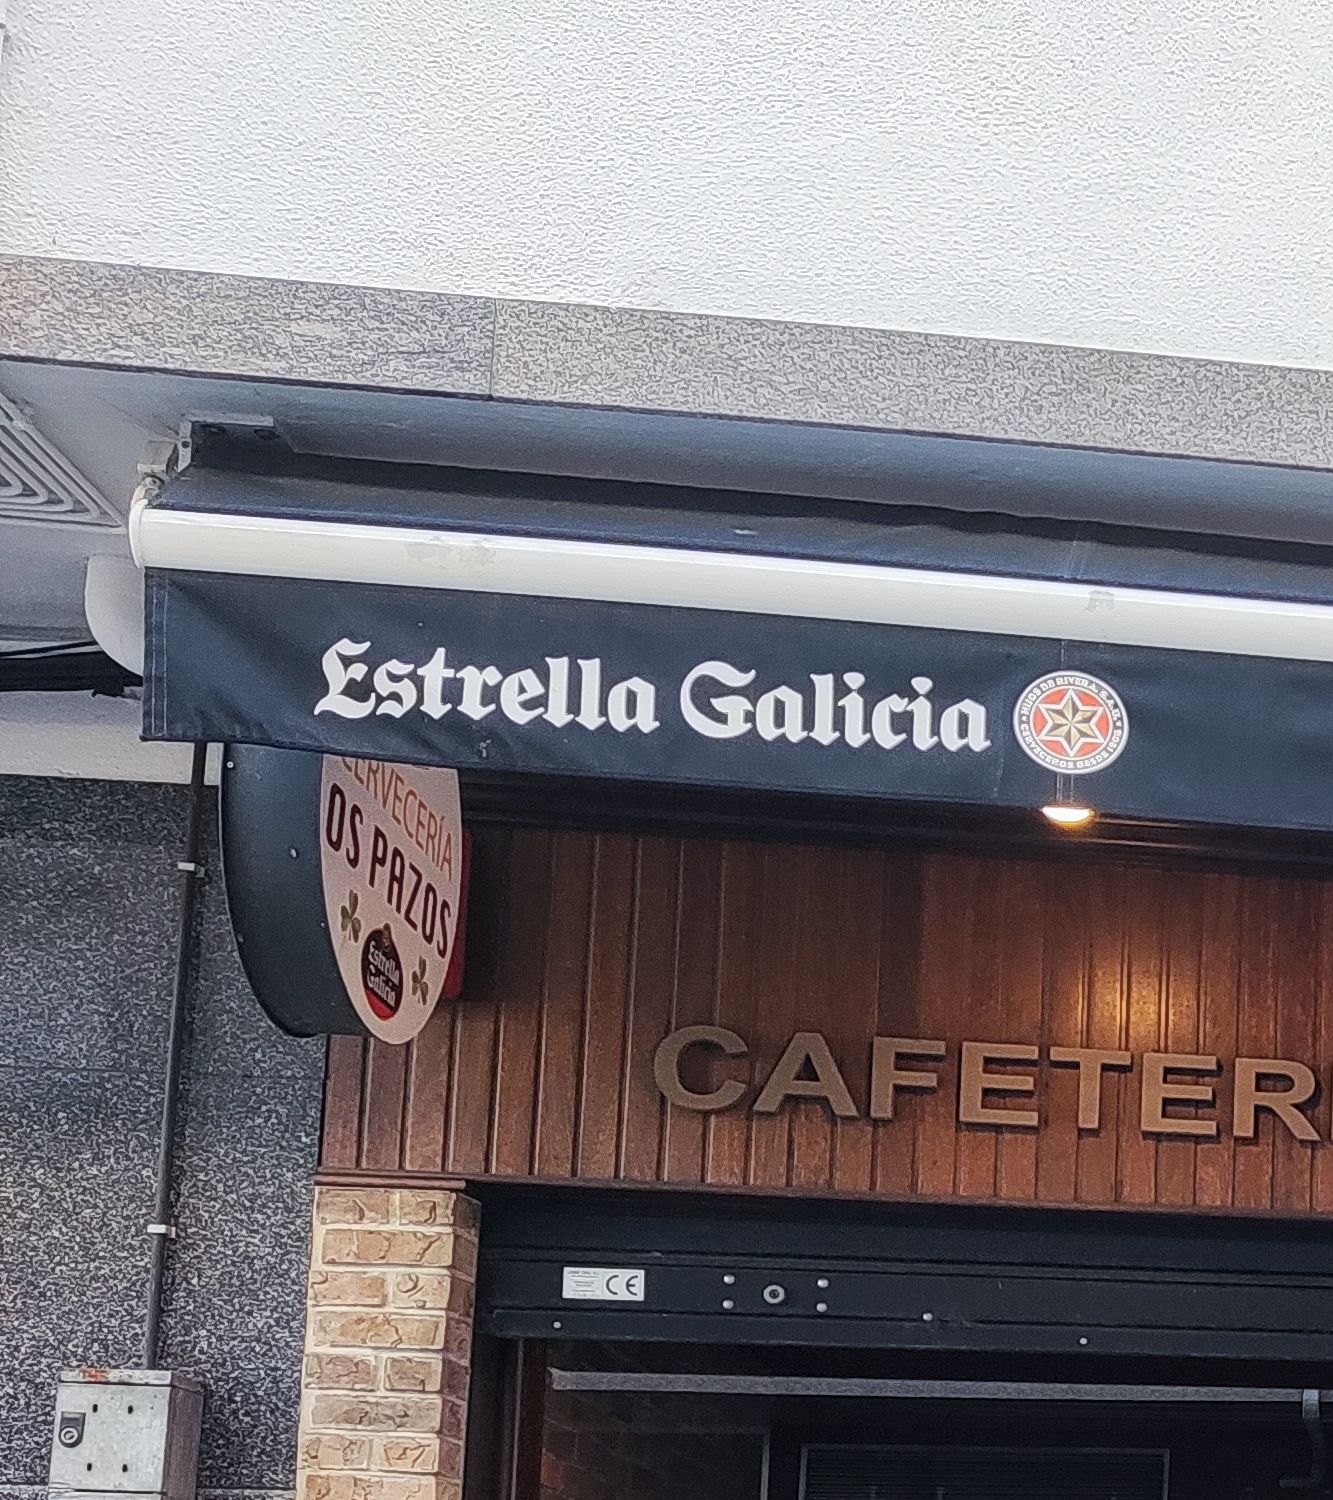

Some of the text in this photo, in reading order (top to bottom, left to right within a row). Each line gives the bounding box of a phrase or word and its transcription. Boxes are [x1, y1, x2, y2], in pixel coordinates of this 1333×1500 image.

[314, 637, 991, 753] Estrella Galicia
[325, 783, 452, 960] OS PAZOS
[366, 964, 397, 1008] Galicia
[368, 940, 400, 986] Estrella
